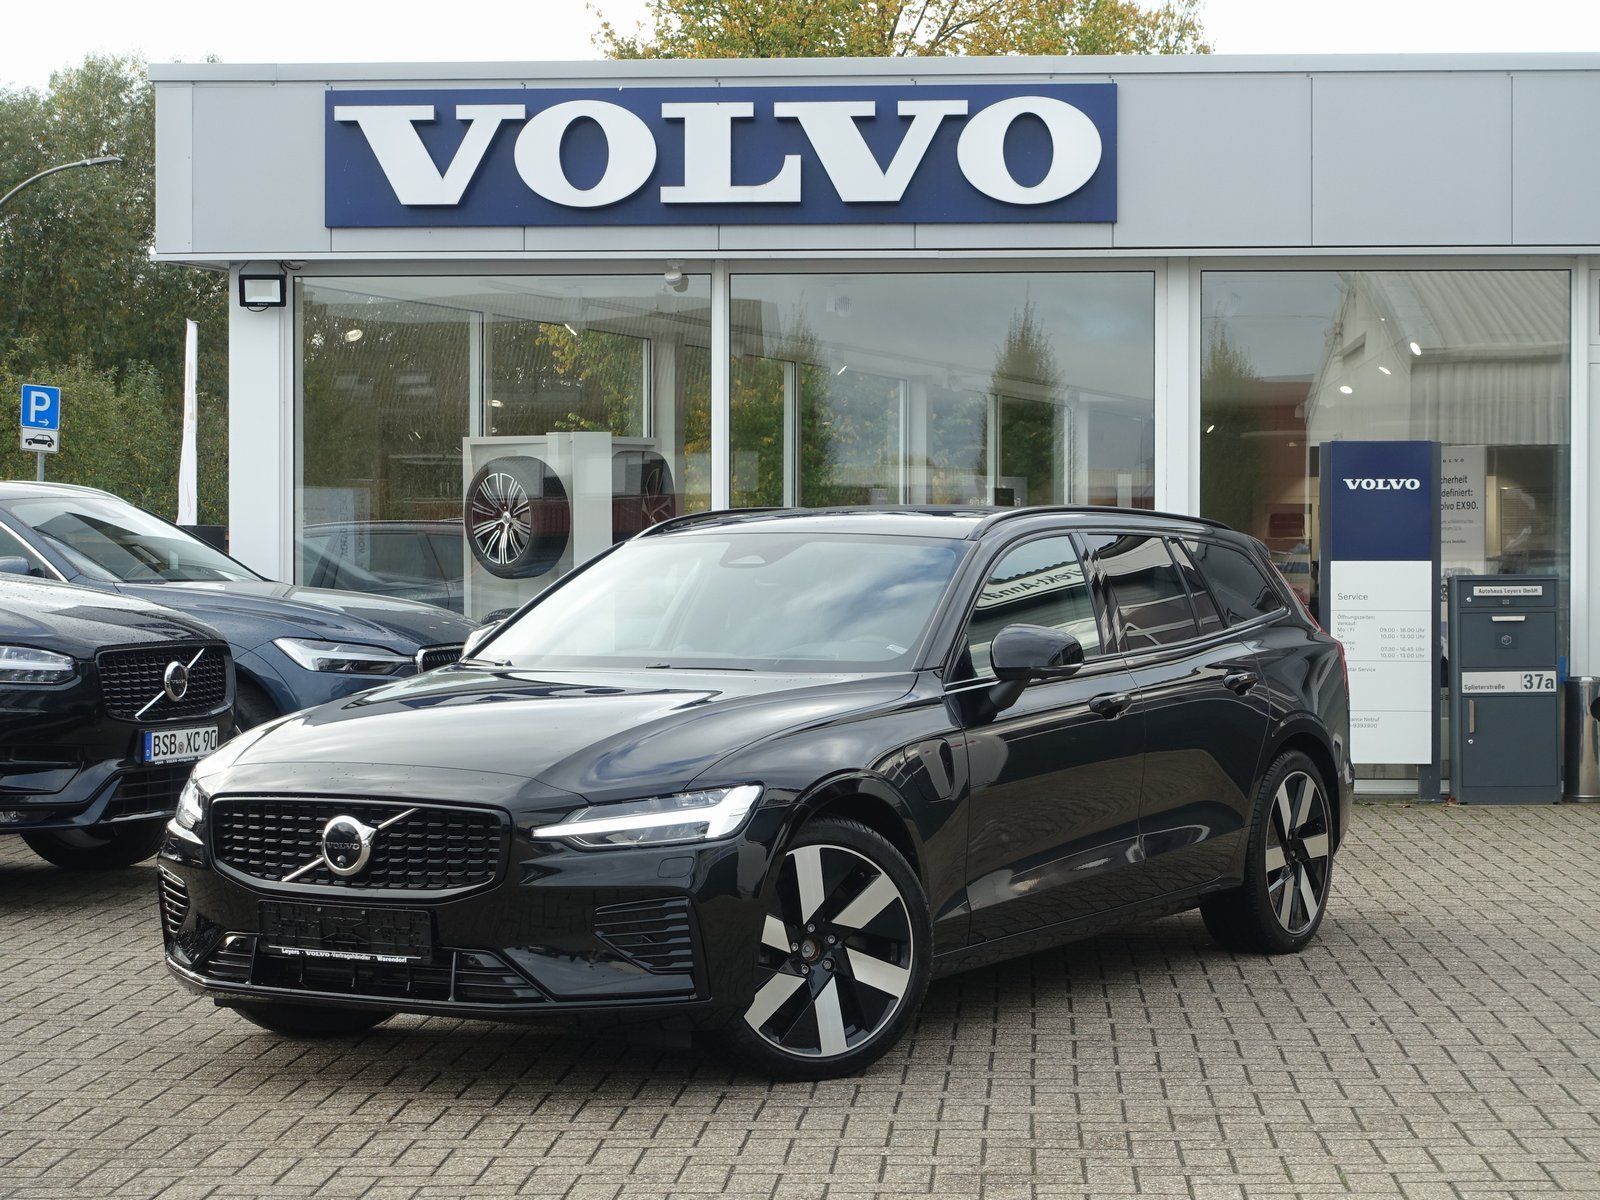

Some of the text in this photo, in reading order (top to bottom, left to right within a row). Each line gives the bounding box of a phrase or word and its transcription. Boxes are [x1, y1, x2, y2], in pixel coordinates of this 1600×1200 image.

[334, 96, 1102, 207] VOLVO
[30, 391, 50, 422] P
[1343, 478, 1421, 490] VOLVO
[1440, 501, 1479, 510] olvo EX90.
[1337, 592, 1369, 601] Service
[1523, 674, 1554, 689] 37a
[153, 729, 217, 756] BSB XC 90
[325, 841, 360, 850] VOLVO
